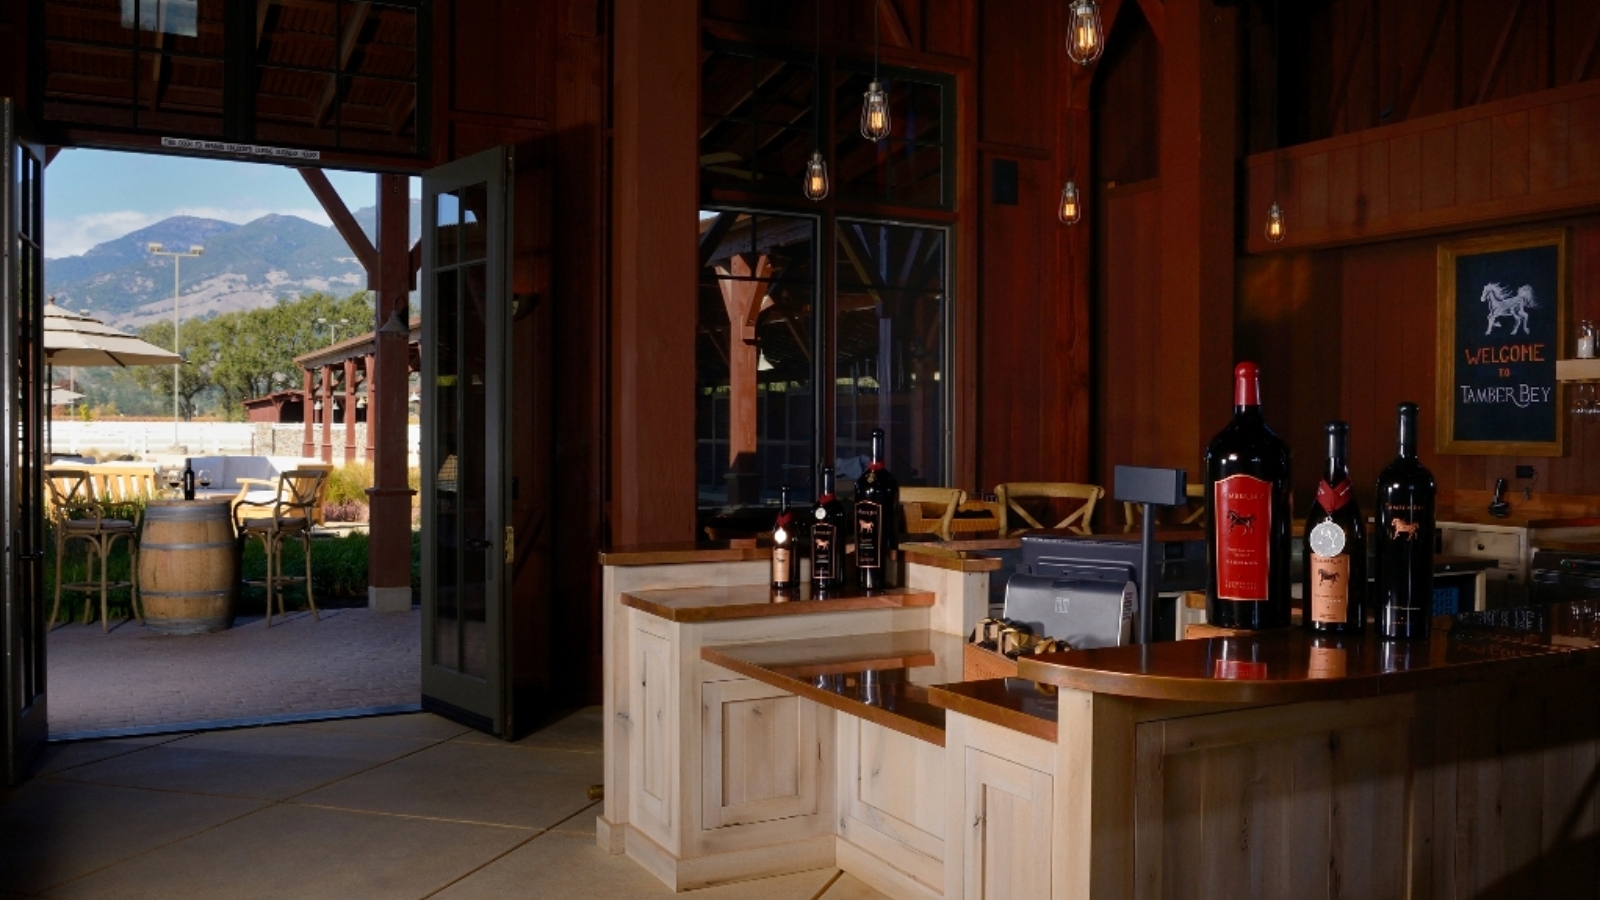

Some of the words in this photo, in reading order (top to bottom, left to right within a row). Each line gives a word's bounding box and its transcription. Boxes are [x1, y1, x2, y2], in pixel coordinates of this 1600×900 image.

[1465, 344, 1545, 364] WELCOME
[1498, 368, 1511, 378] TO
[1460, 385, 1521, 405] TAMBER
[1519, 383, 1551, 404] BEY
